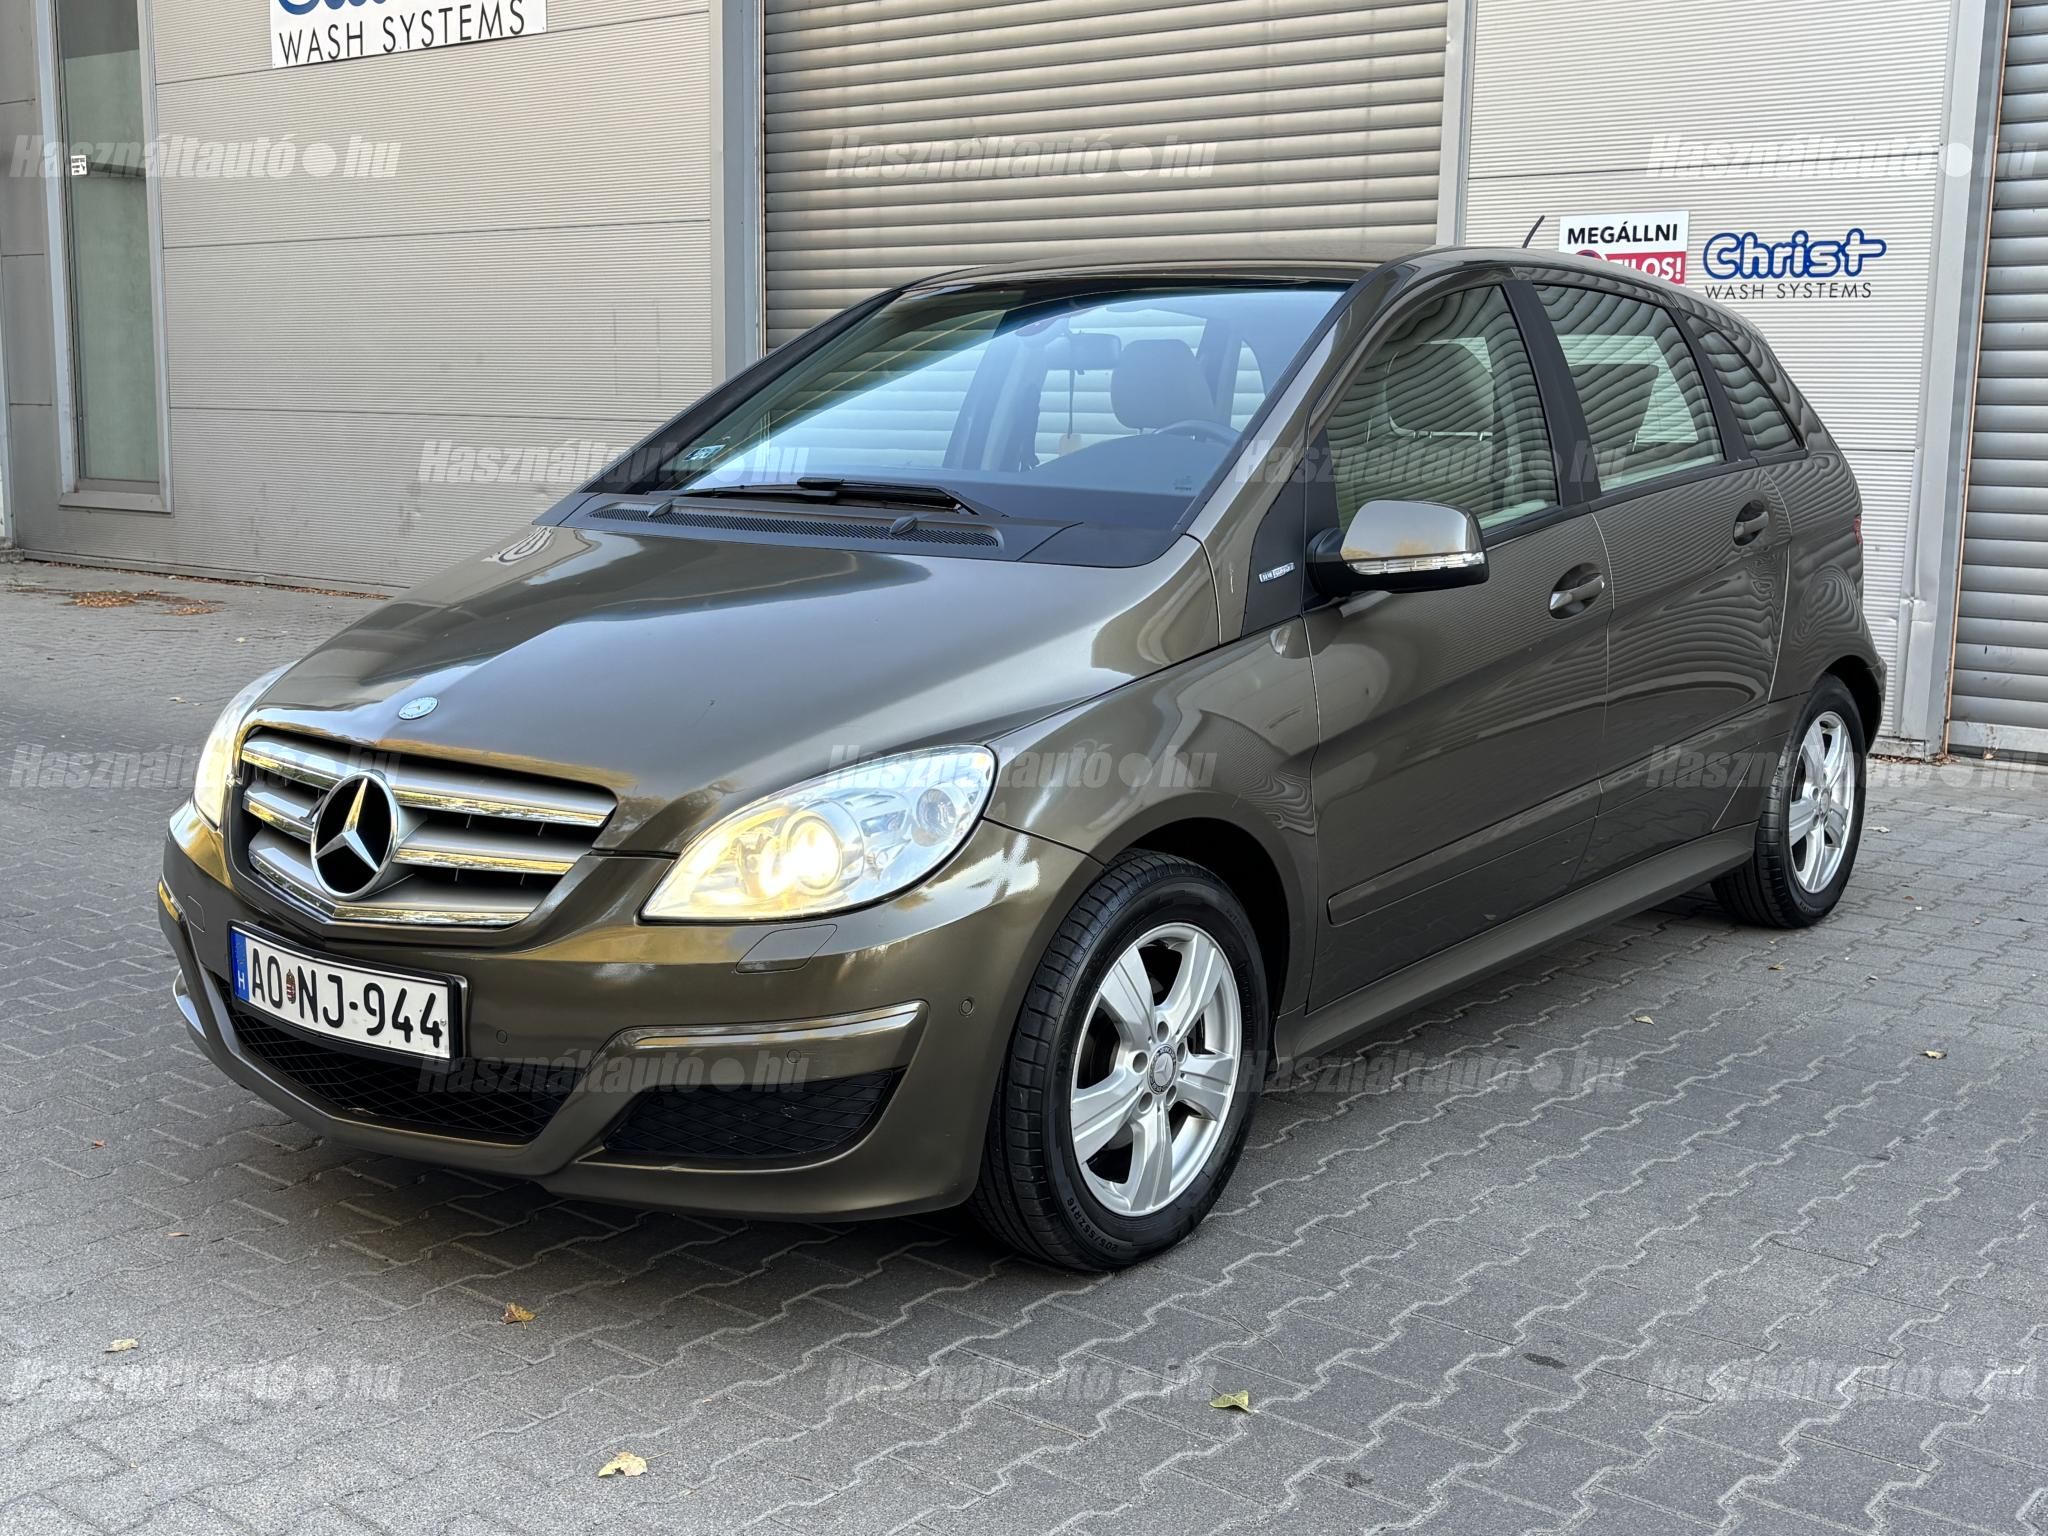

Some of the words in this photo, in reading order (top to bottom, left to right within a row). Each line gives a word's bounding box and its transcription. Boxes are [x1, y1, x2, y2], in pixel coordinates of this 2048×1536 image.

[279, 21, 363, 65] WASH
[382, 0, 525, 53] SYSTEMS
[1567, 222, 1678, 244] MEGÁLLNI
[1608, 257, 1682, 281] OS!
[1703, 228, 1887, 279] Christ
[1705, 283, 1764, 299] WASH
[1776, 283, 1872, 298] SYSTEMS
[237, 972, 246, 991] H
[252, 948, 283, 1009] AO
[297, 965, 442, 1048] NJ-944
[1067, 1197, 1118, 1252] 205/55ZR16
